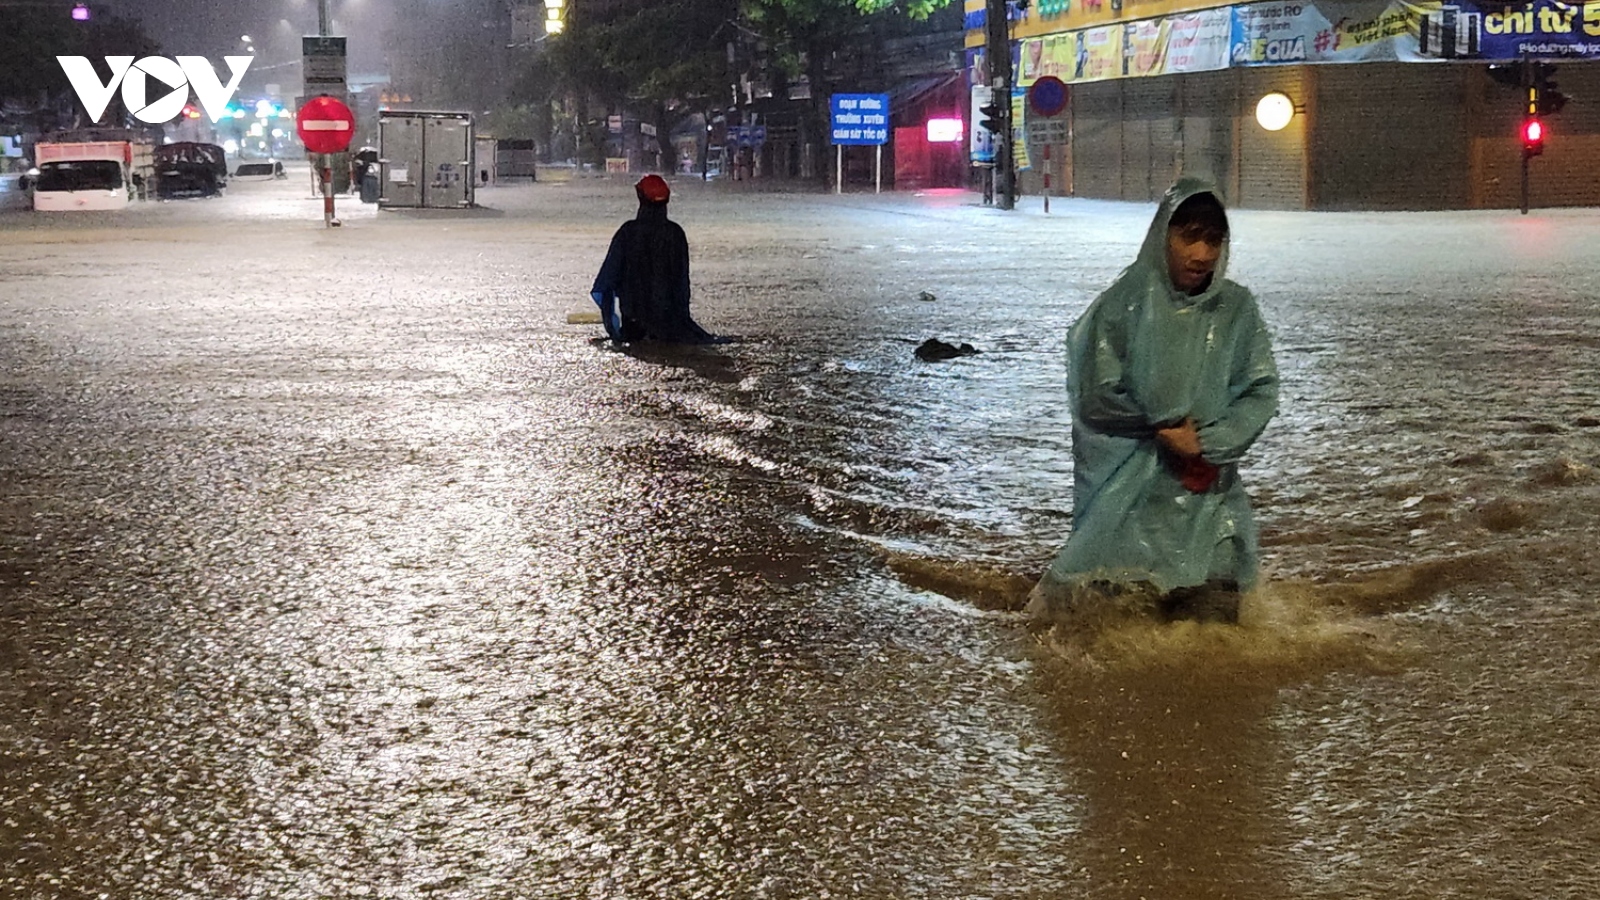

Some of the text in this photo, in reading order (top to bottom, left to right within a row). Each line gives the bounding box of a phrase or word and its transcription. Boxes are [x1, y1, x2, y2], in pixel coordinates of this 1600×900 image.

[1284, 6, 1302, 17] RO
[1485, 3, 1534, 34] chỉ
[1538, 5, 1578, 33] từ
[1266, 35, 1306, 61] QUÁ
[863, 114, 884, 124] XUYÊN
